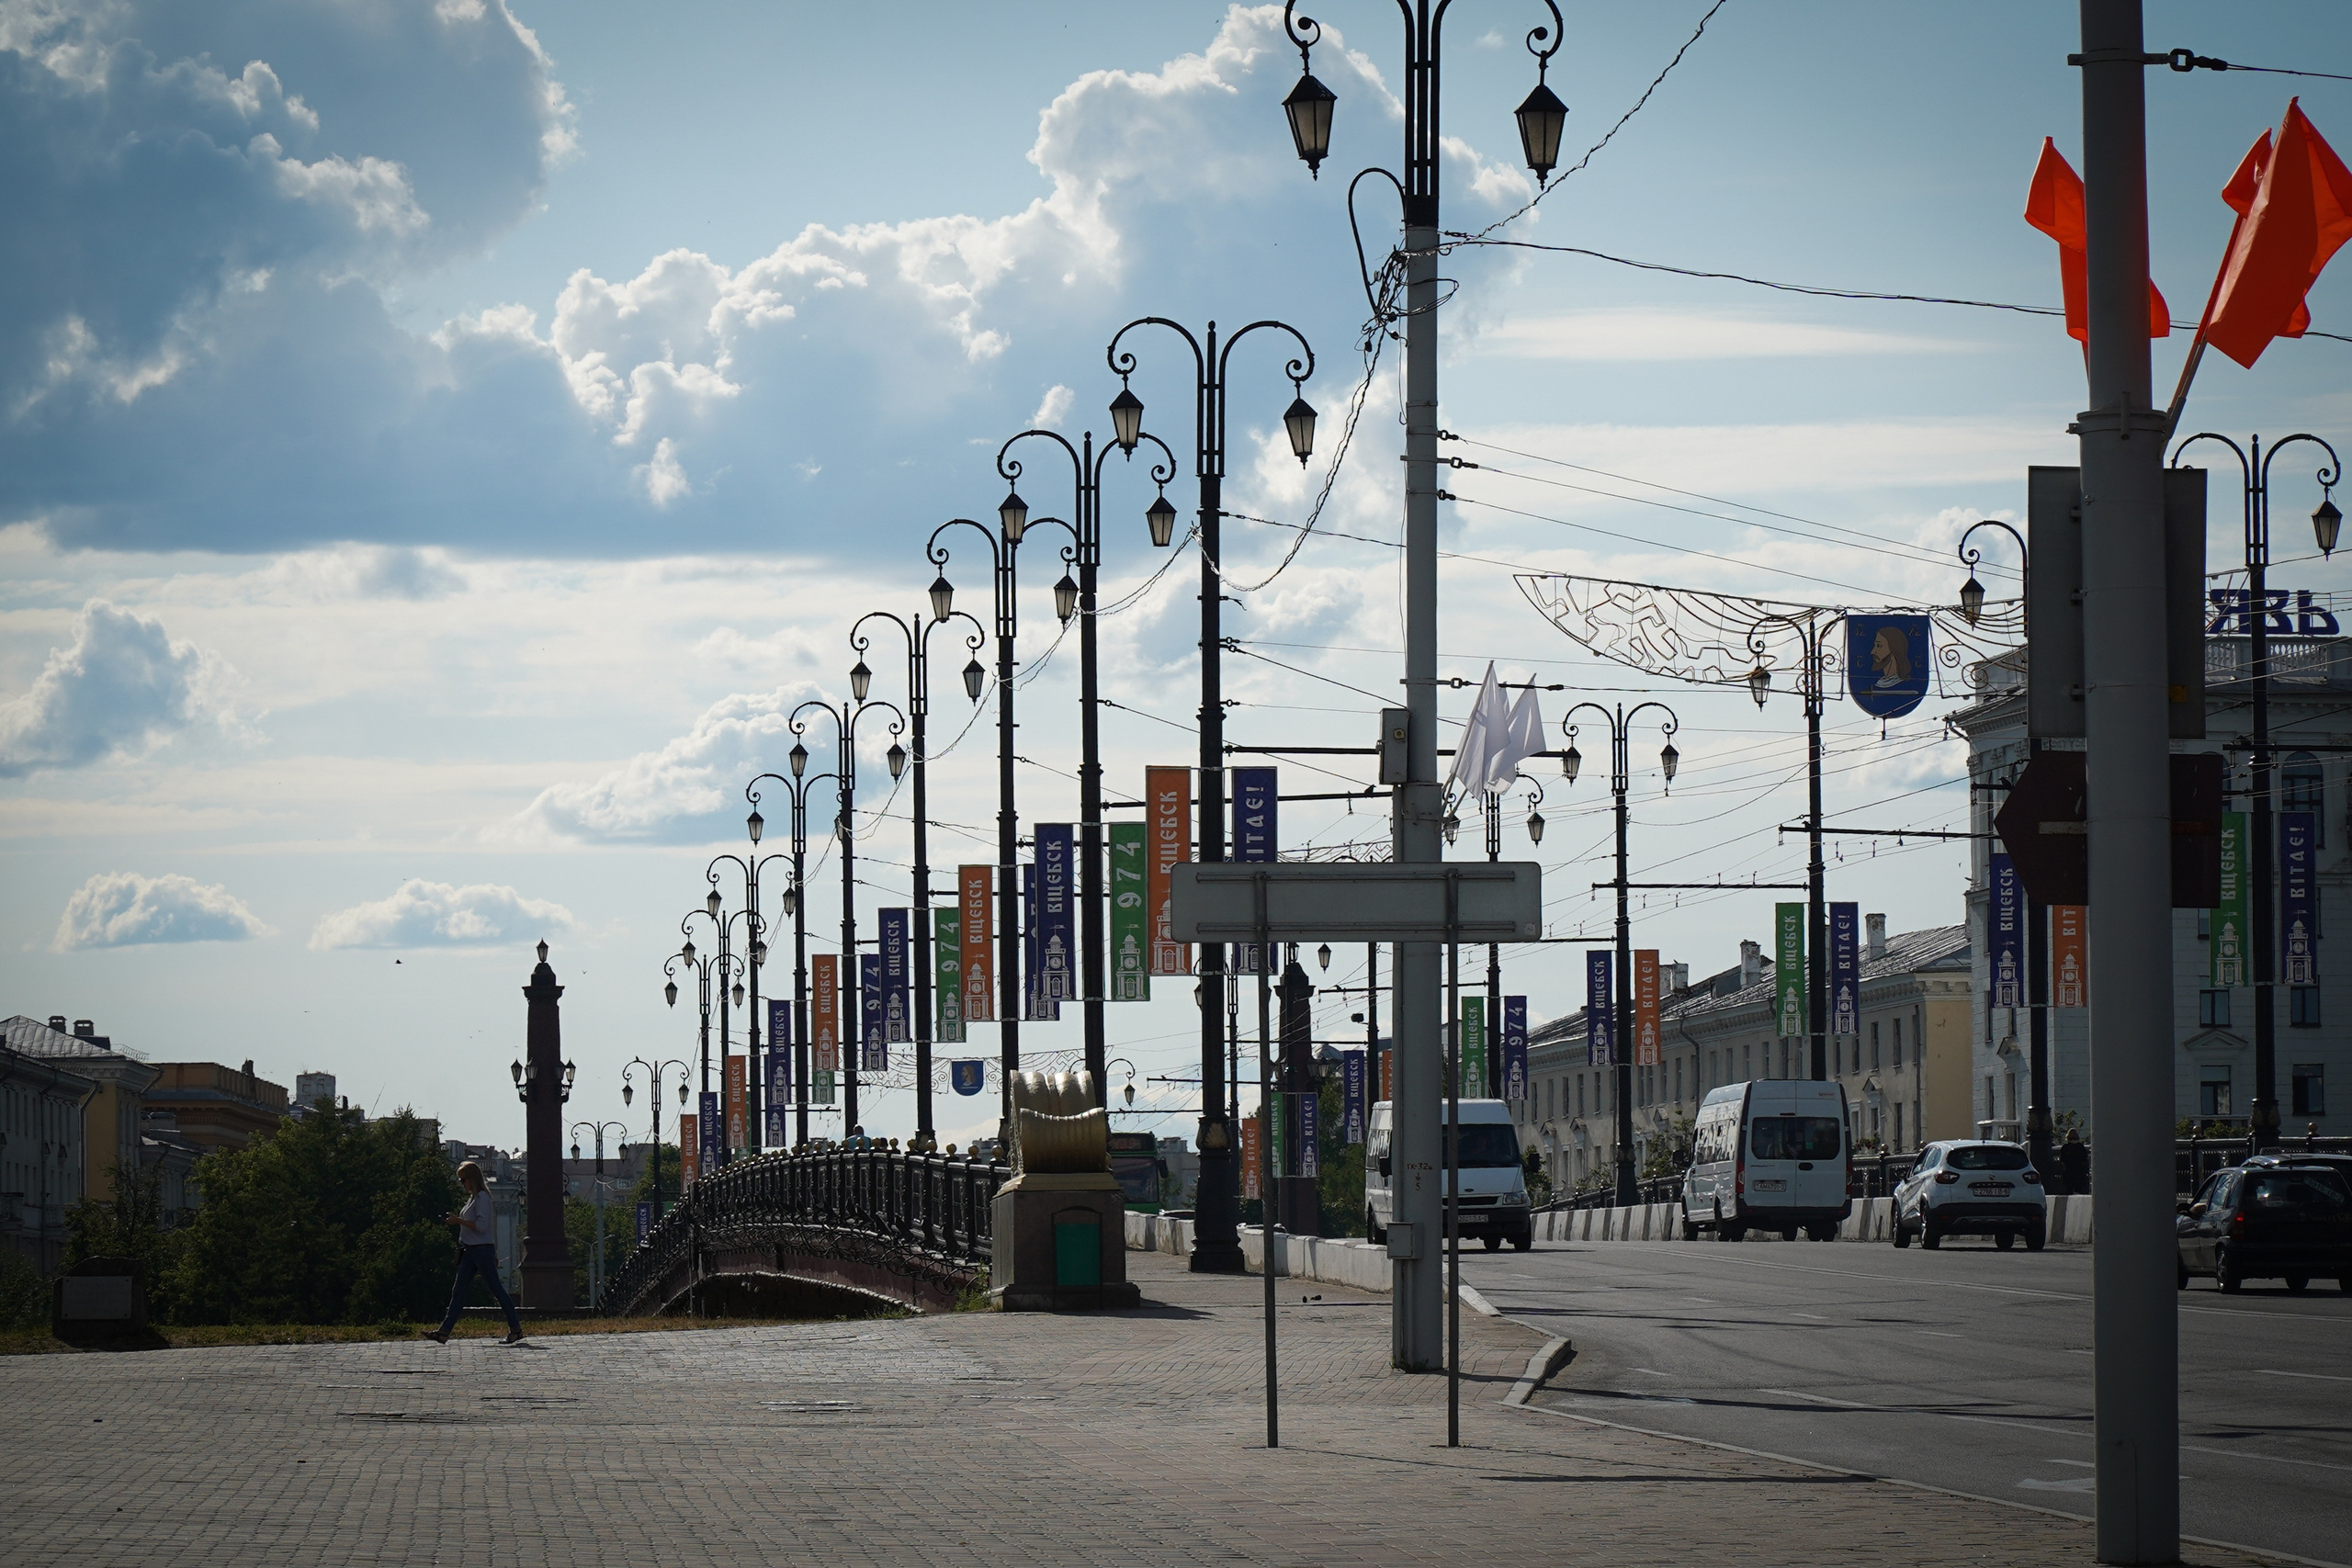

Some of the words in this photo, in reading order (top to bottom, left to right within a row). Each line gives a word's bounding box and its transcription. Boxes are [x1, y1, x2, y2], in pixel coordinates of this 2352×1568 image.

[1246, 786, 1264, 862] ІТАЕ!
[1046, 840, 1065, 912] ВІЦЕБСК
[1116, 842, 1141, 908] 974
[940, 922, 958, 972] 974
[2063, 909, 2075, 936] ВІТ
[1509, 1007, 1523, 1045] 974
